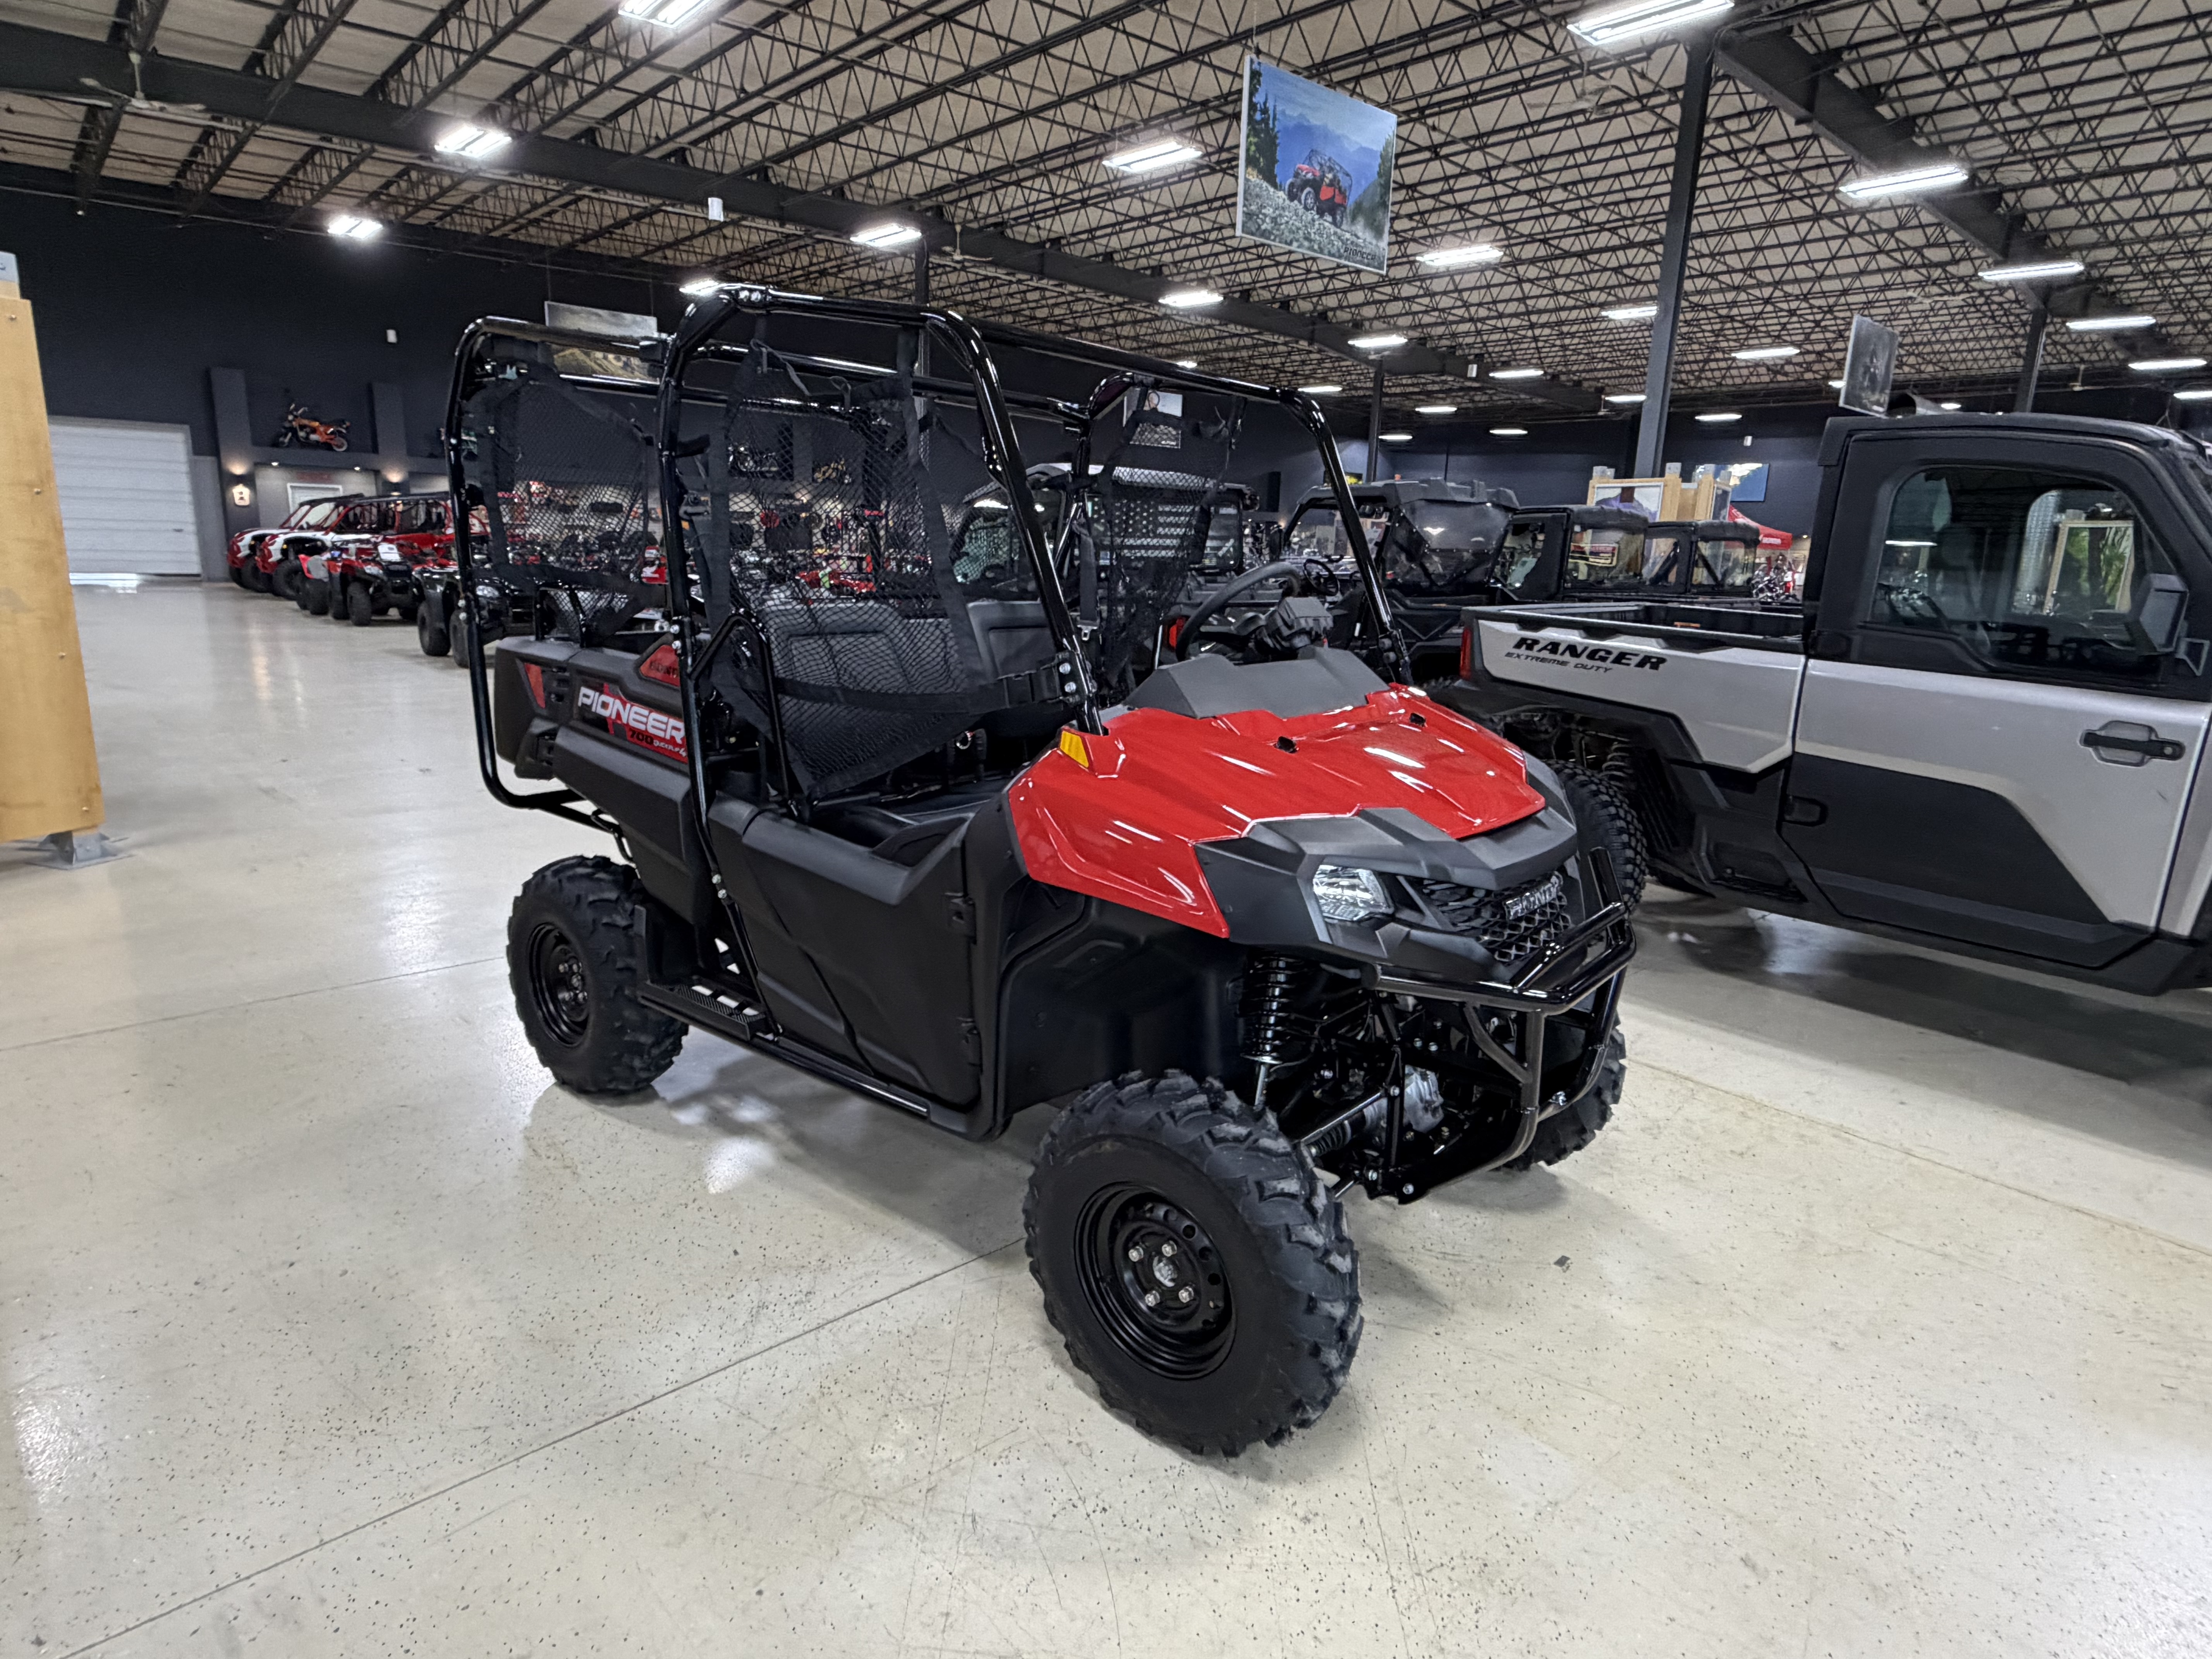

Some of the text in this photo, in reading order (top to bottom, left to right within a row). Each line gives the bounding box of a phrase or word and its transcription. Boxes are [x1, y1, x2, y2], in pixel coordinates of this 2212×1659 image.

[1504, 652, 1613, 673] EXTREME DUTY
[1512, 637, 1667, 671] RANGER
[578, 686, 685, 744] PIONEER
[629, 728, 654, 745] 700
